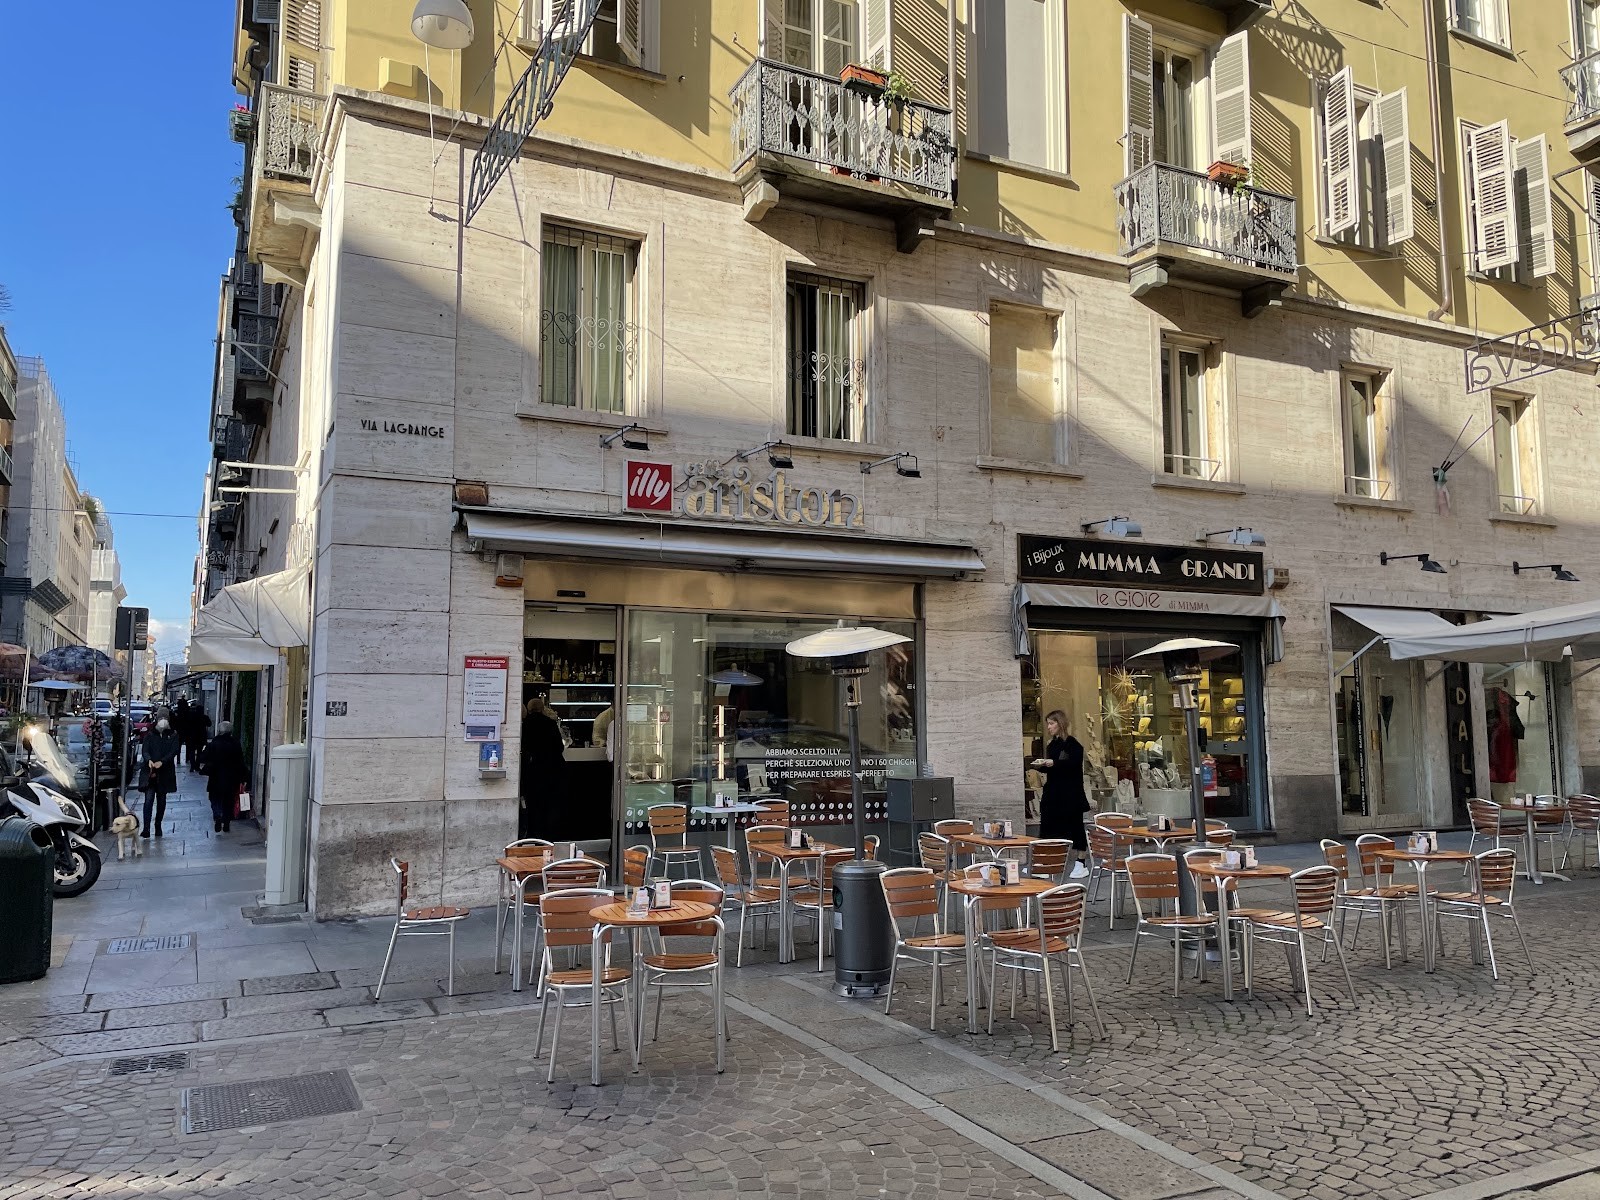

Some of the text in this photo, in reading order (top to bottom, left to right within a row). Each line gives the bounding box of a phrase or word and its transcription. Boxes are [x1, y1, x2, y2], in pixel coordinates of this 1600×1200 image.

[361, 419, 445, 439] VIA LAGRANGE
[629, 466, 671, 506] illy
[683, 465, 866, 529] ariston
[1027, 543, 1064, 571] i Bijoux
[1054, 559, 1065, 574] di
[1077, 551, 1255, 581] MIMMA GRANDI
[1178, 603, 1210, 612] MIMMA
[765, 748, 841, 756] ABBIAMO SCELTO ILLY
[795, 759, 833, 767] SELEZIONA
[834, 758, 851, 767] UNO
[879, 758, 887, 766] 60
[888, 758, 917, 766] CHICCHI
[765, 771, 779, 779] PER
[780, 770, 820, 779] PREPARARE
[861, 769, 895, 777] PERFETTO
